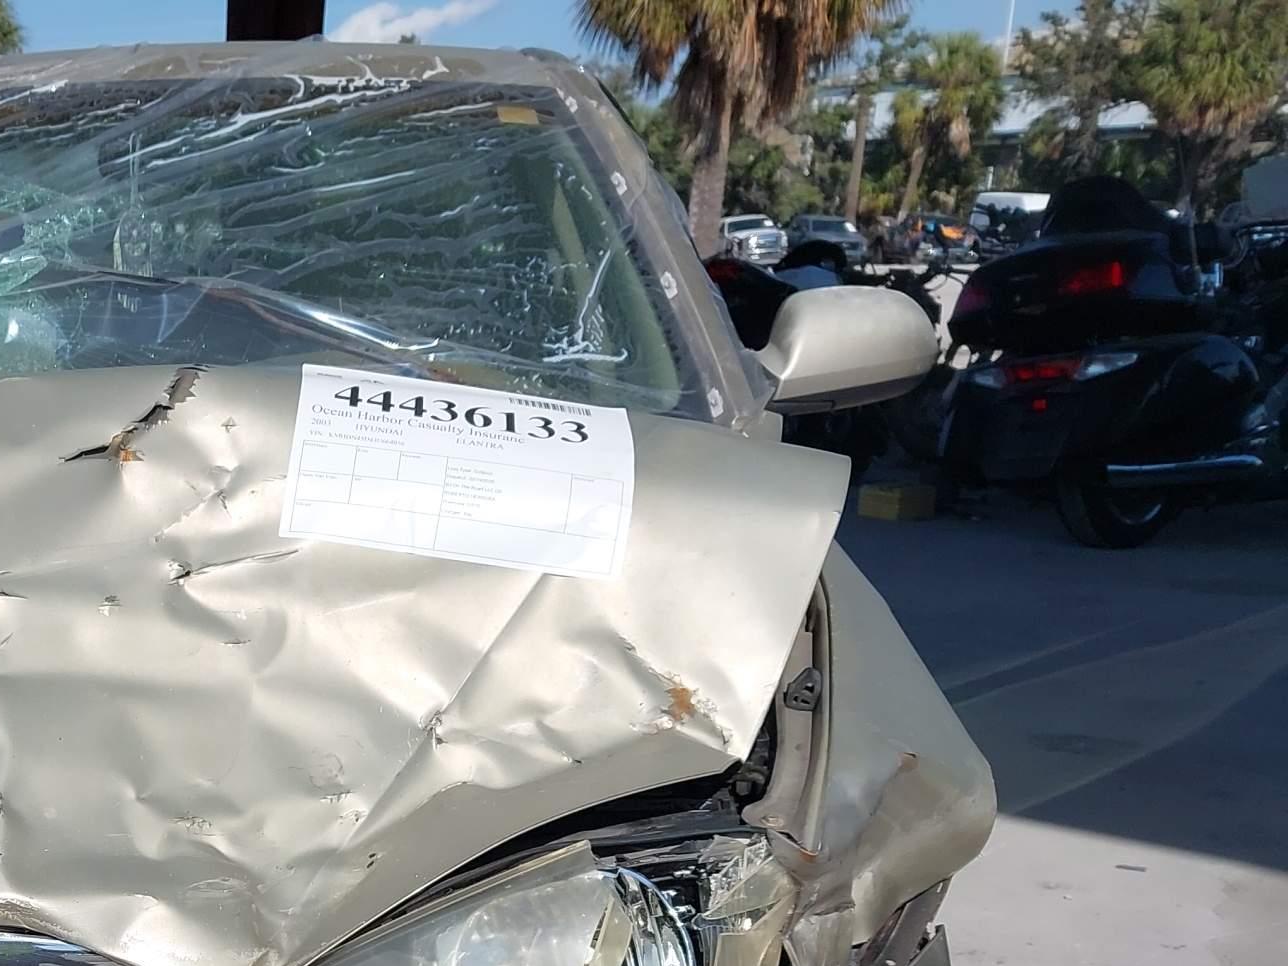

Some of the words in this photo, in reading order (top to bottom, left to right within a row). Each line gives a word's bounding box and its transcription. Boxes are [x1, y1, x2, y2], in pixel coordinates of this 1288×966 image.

[312, 404, 353, 418] Ocean
[357, 410, 406, 425] Harbor
[408, 418, 464, 436] Casualty
[334, 385, 590, 443] 44436133
[355, 423, 403, 437] HYUNDAI
